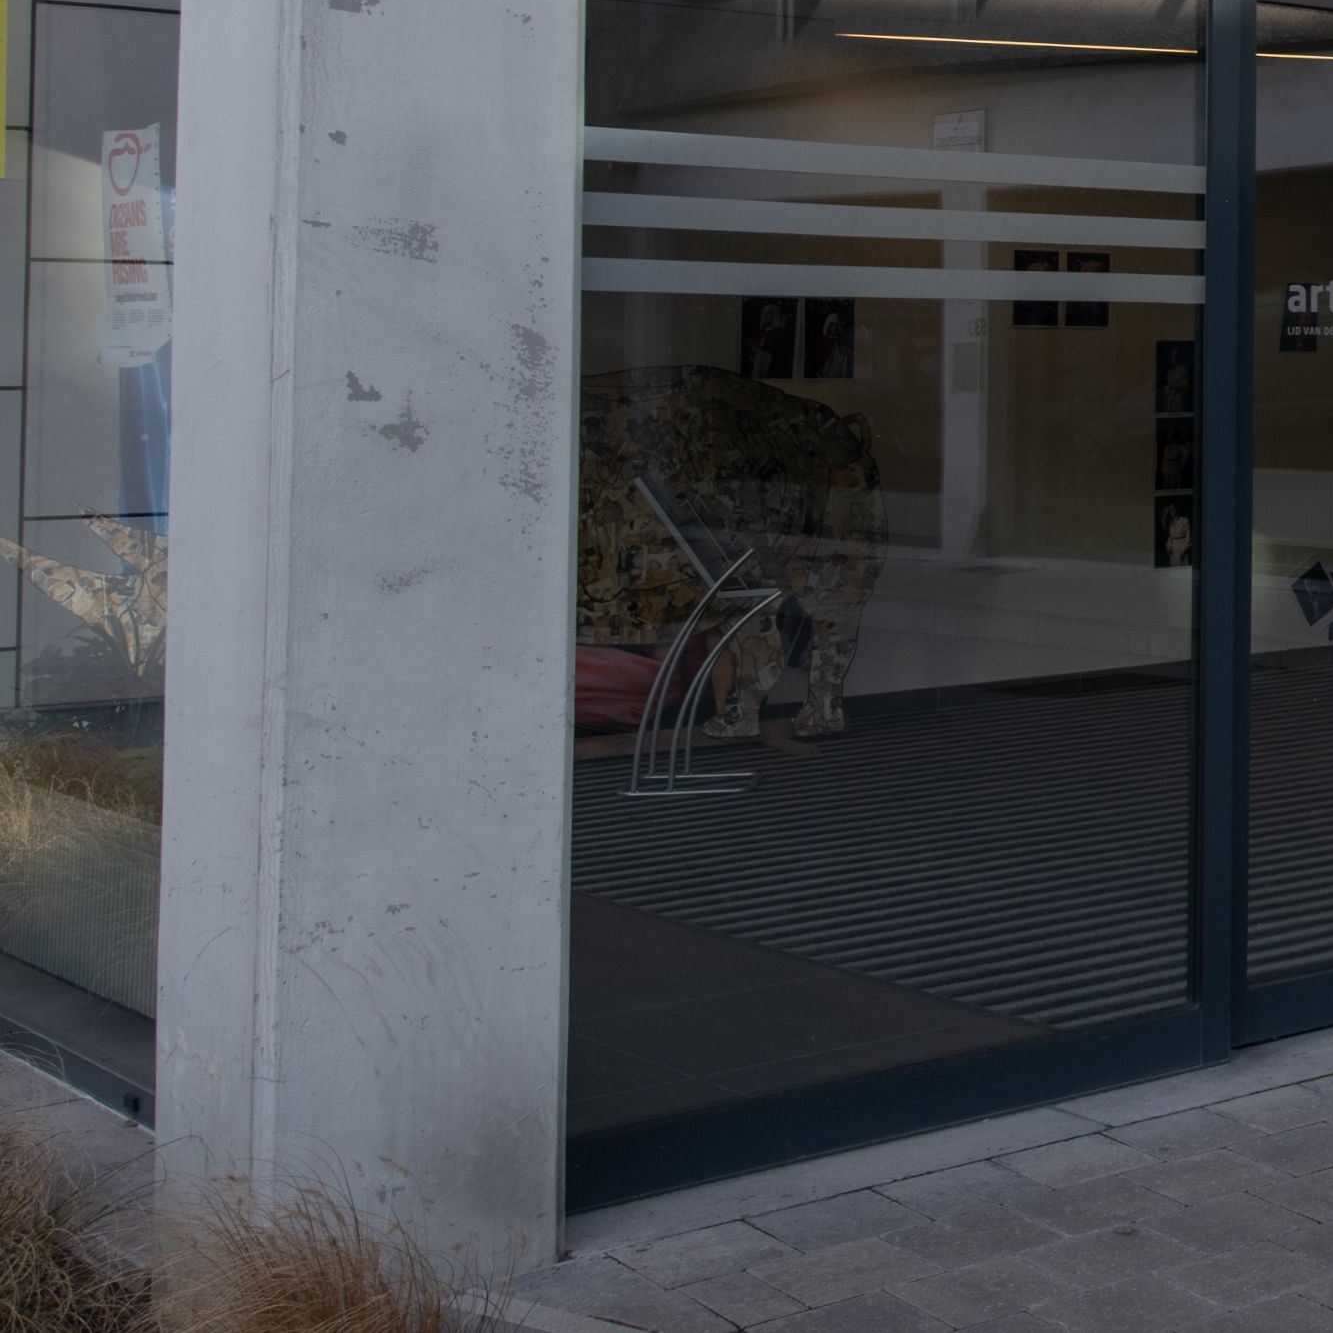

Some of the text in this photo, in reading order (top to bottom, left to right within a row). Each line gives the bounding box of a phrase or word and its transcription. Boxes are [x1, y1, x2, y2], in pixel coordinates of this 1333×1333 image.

[108, 200, 147, 229] OCEANS
[110, 230, 130, 257] ARE
[111, 257, 149, 285] RISING
[1287, 326, 1301, 335] LID
[1304, 326, 1321, 336] VAN
